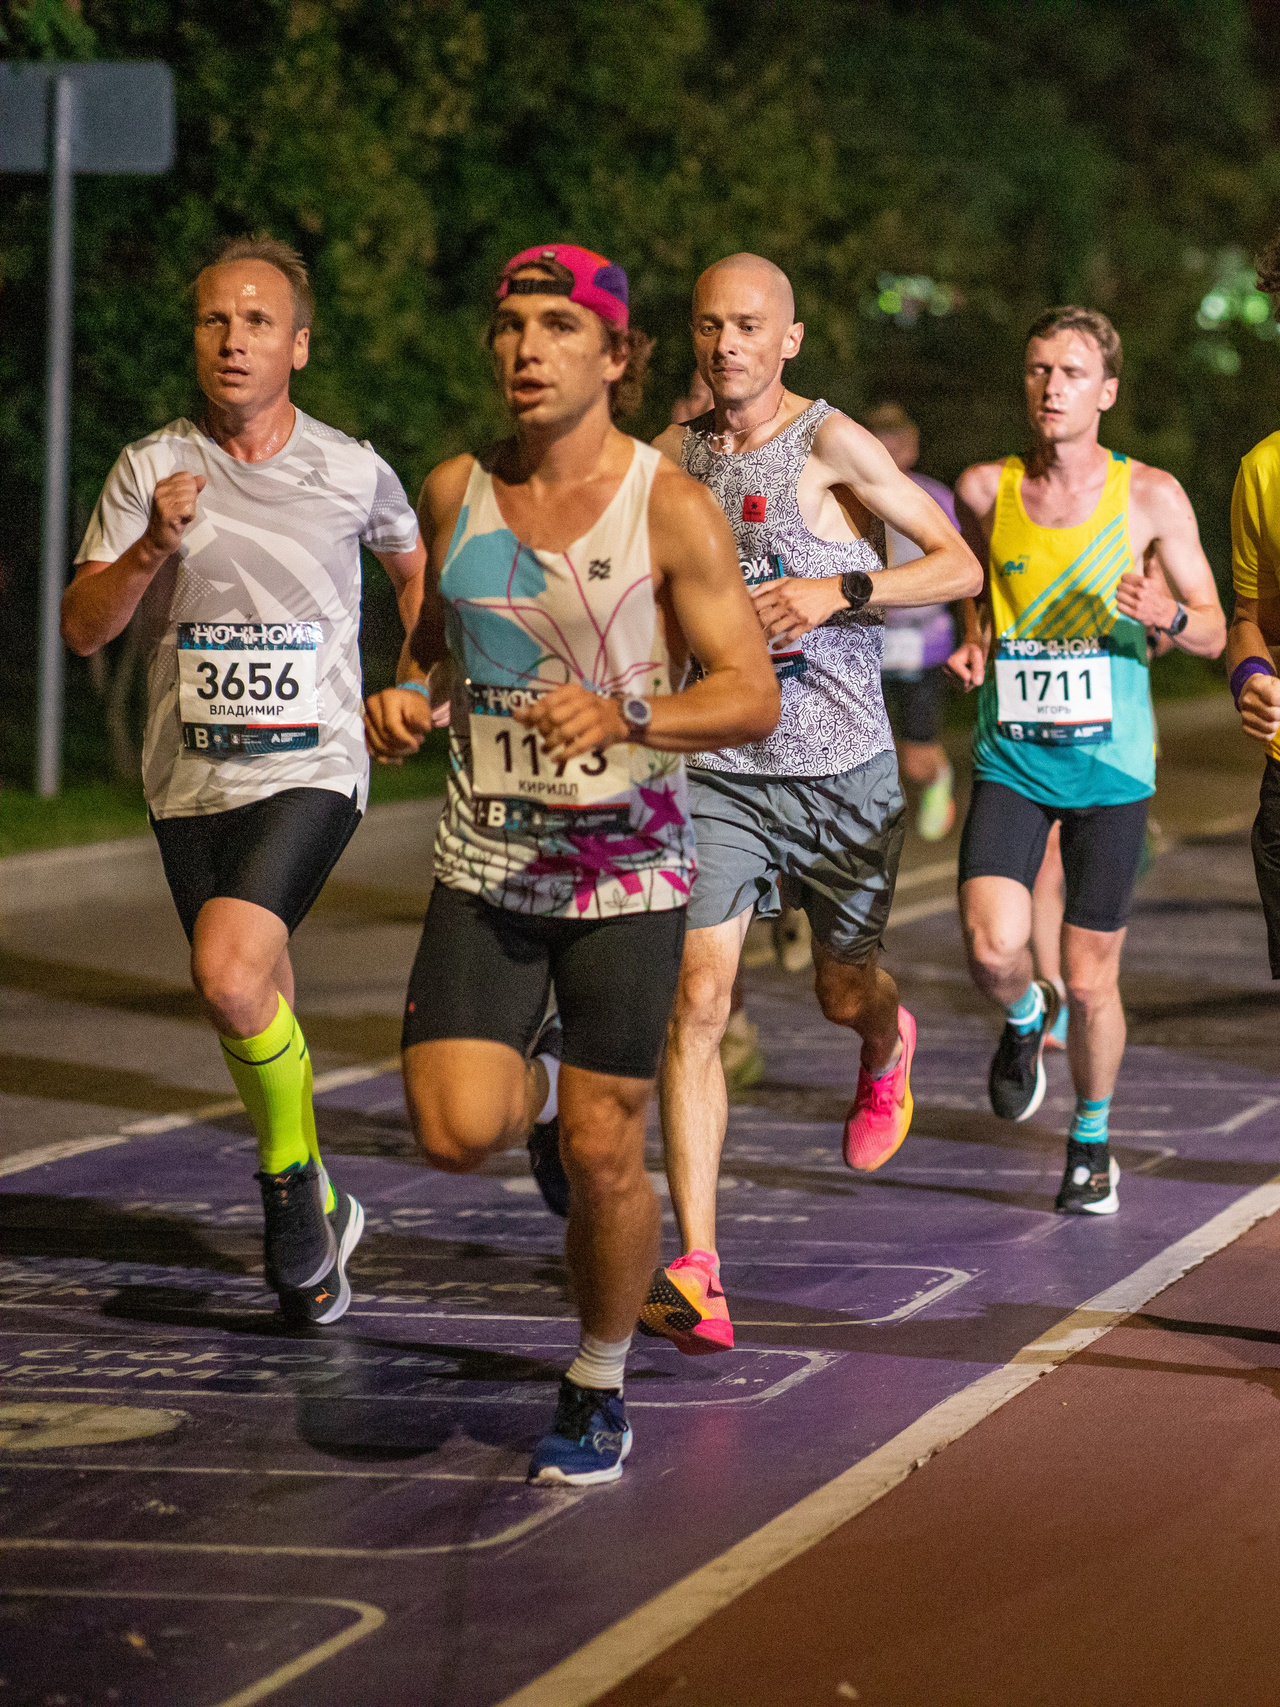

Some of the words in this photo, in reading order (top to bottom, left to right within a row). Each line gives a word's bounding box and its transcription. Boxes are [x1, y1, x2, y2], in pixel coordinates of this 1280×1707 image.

[196, 662, 300, 701] 3656
[1015, 669, 1092, 701] 1711
[209, 705, 285, 717] ВЛАДИМИР
[1037, 705, 1072, 715] ИГОРЬ
[518, 780, 578, 796] КИРИЛЛ
